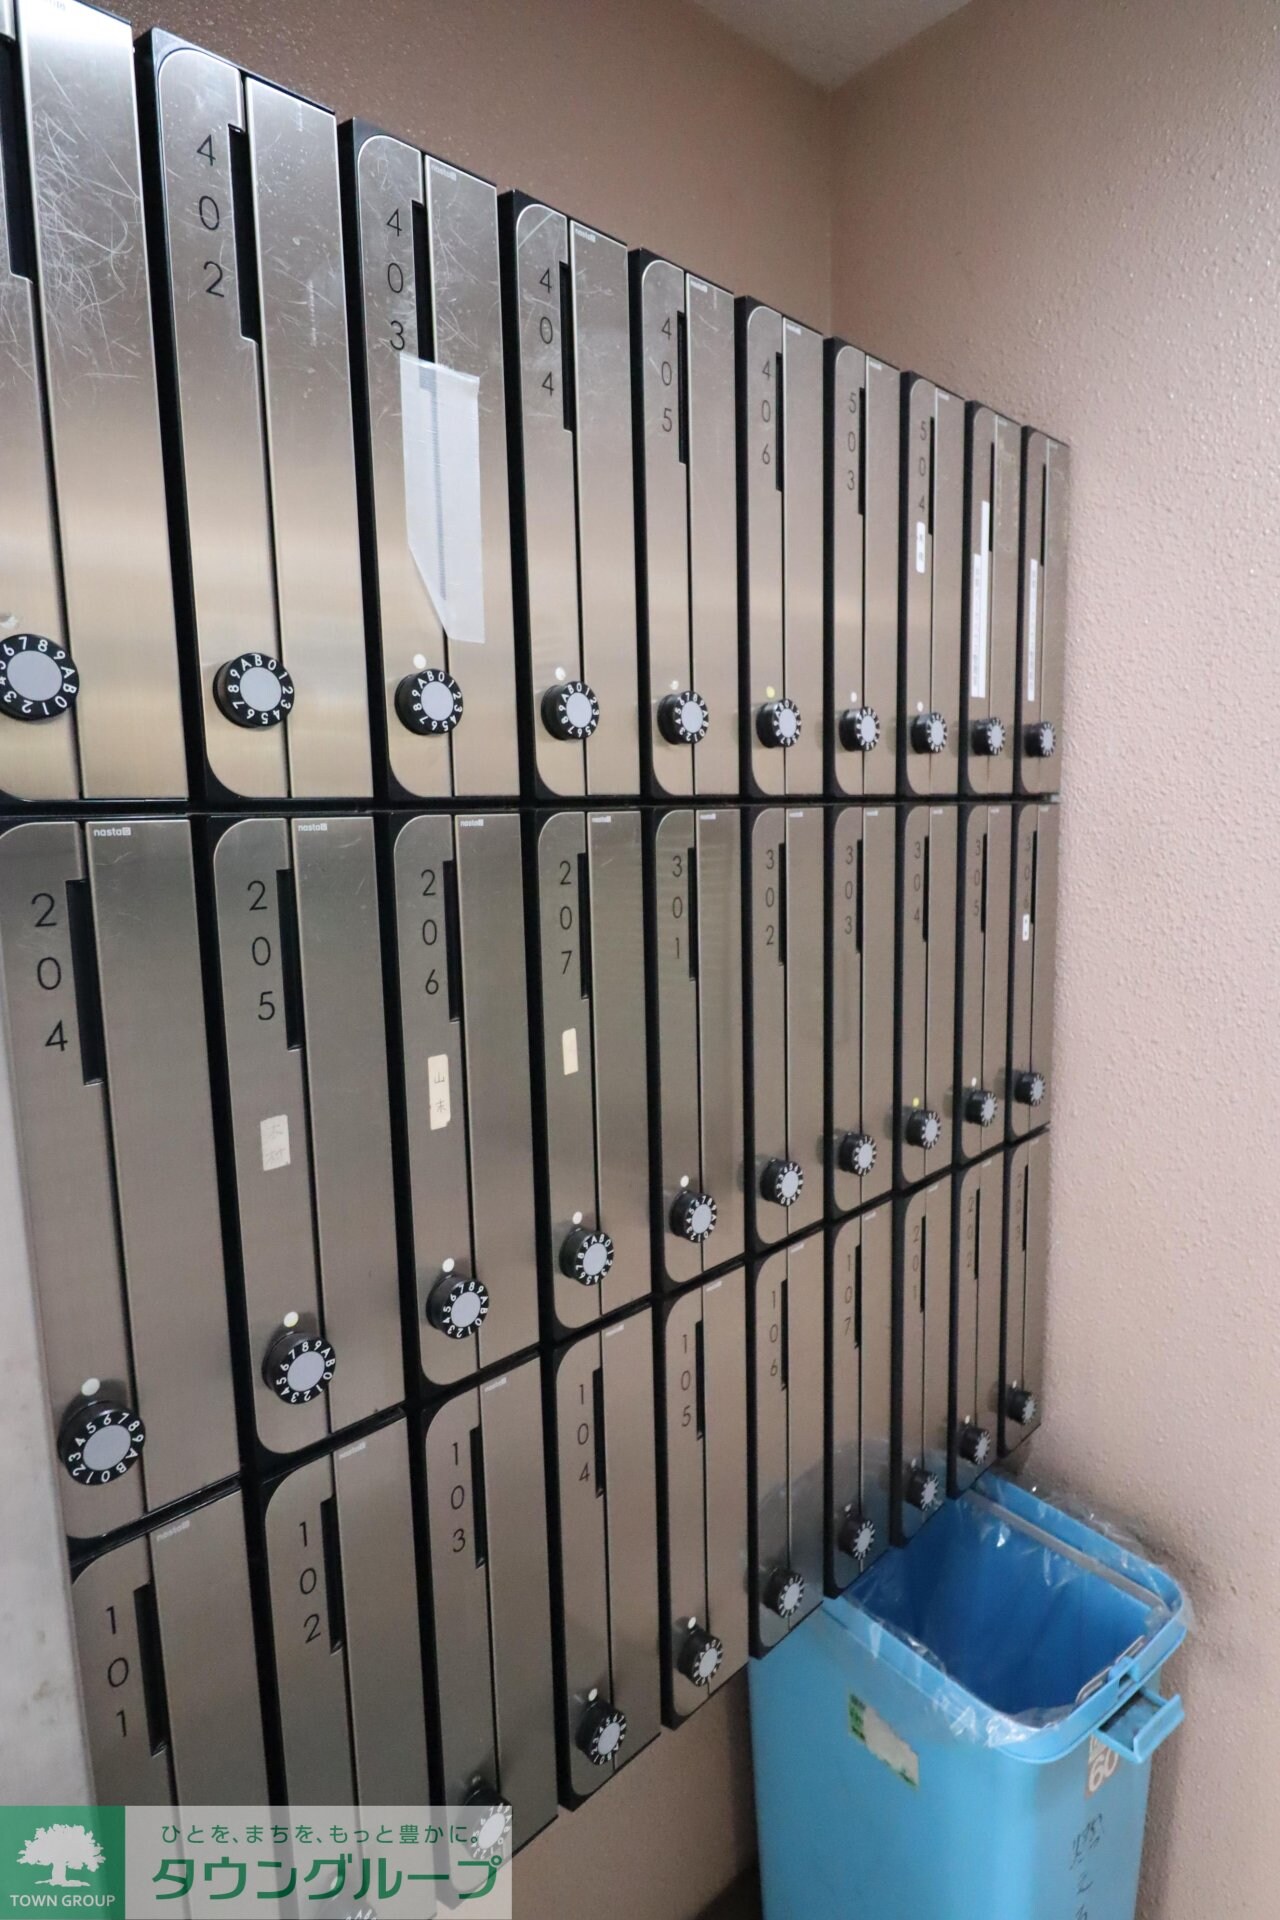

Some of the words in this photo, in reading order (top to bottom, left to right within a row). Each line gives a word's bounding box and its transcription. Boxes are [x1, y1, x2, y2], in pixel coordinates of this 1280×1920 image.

[196, 134, 225, 298] 402
[386, 208, 406, 351] 403
[539, 267, 555, 396] 404
[661, 316, 673, 433] 405
[761, 357, 771, 465] 406
[847, 392, 857, 491] 503
[918, 421, 927, 512] 504
[421, 869, 439, 996] 206
[559, 861, 573, 976] 207
[672, 855, 683, 960] 301
[765, 848, 775, 946] 302
[844, 845, 854, 935] 303
[913, 840, 921, 924] 304
[31, 892, 69, 1052] 204
[247, 880, 276, 1022] 205
[769, 1288, 778, 1377] 106
[844, 1252, 853, 1338] 107
[576, 1383, 590, 1483] 104
[681, 1333, 691, 1427] 105
[450, 1442, 467, 1553] 103
[299, 1520, 321, 1645] 102
[106, 1605, 128, 1739] 101
